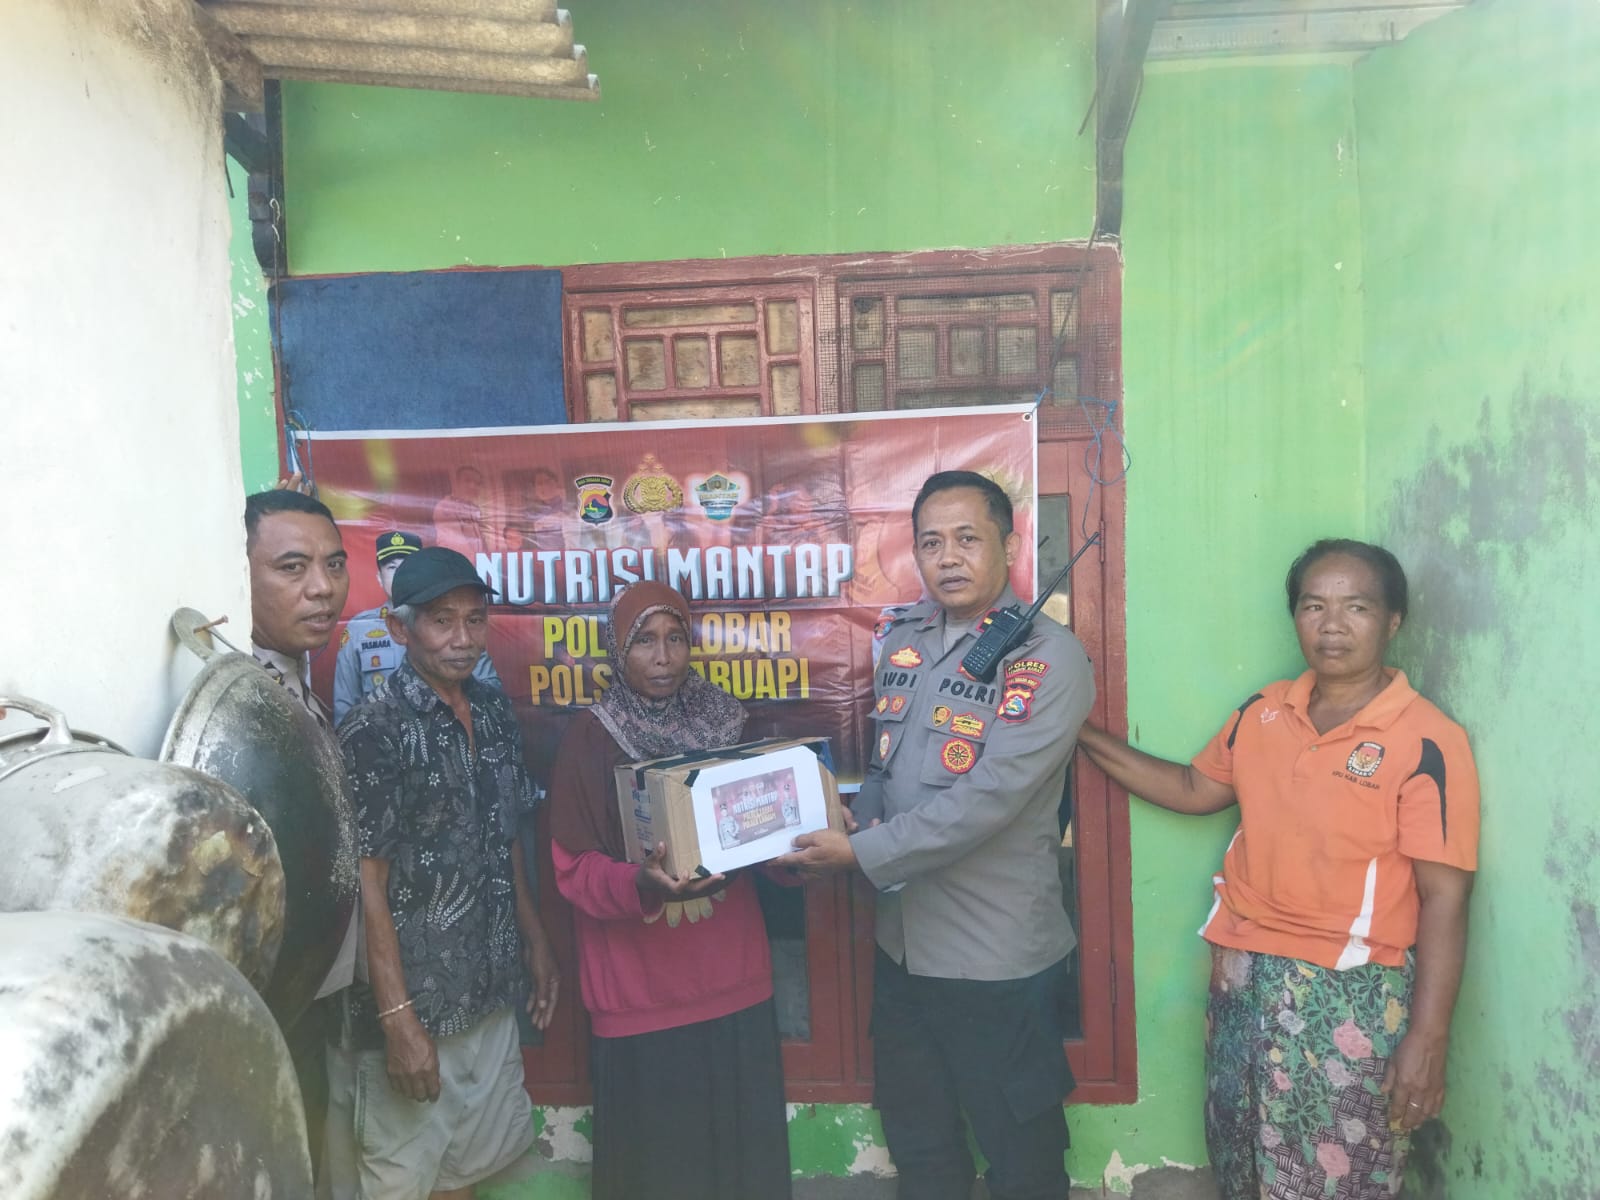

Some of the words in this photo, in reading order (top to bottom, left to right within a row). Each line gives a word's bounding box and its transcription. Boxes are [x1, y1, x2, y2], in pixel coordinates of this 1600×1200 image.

[476, 549, 656, 605] NUTRISI
[668, 543, 853, 601] MANTAP
[940, 678, 996, 704] POLRI
